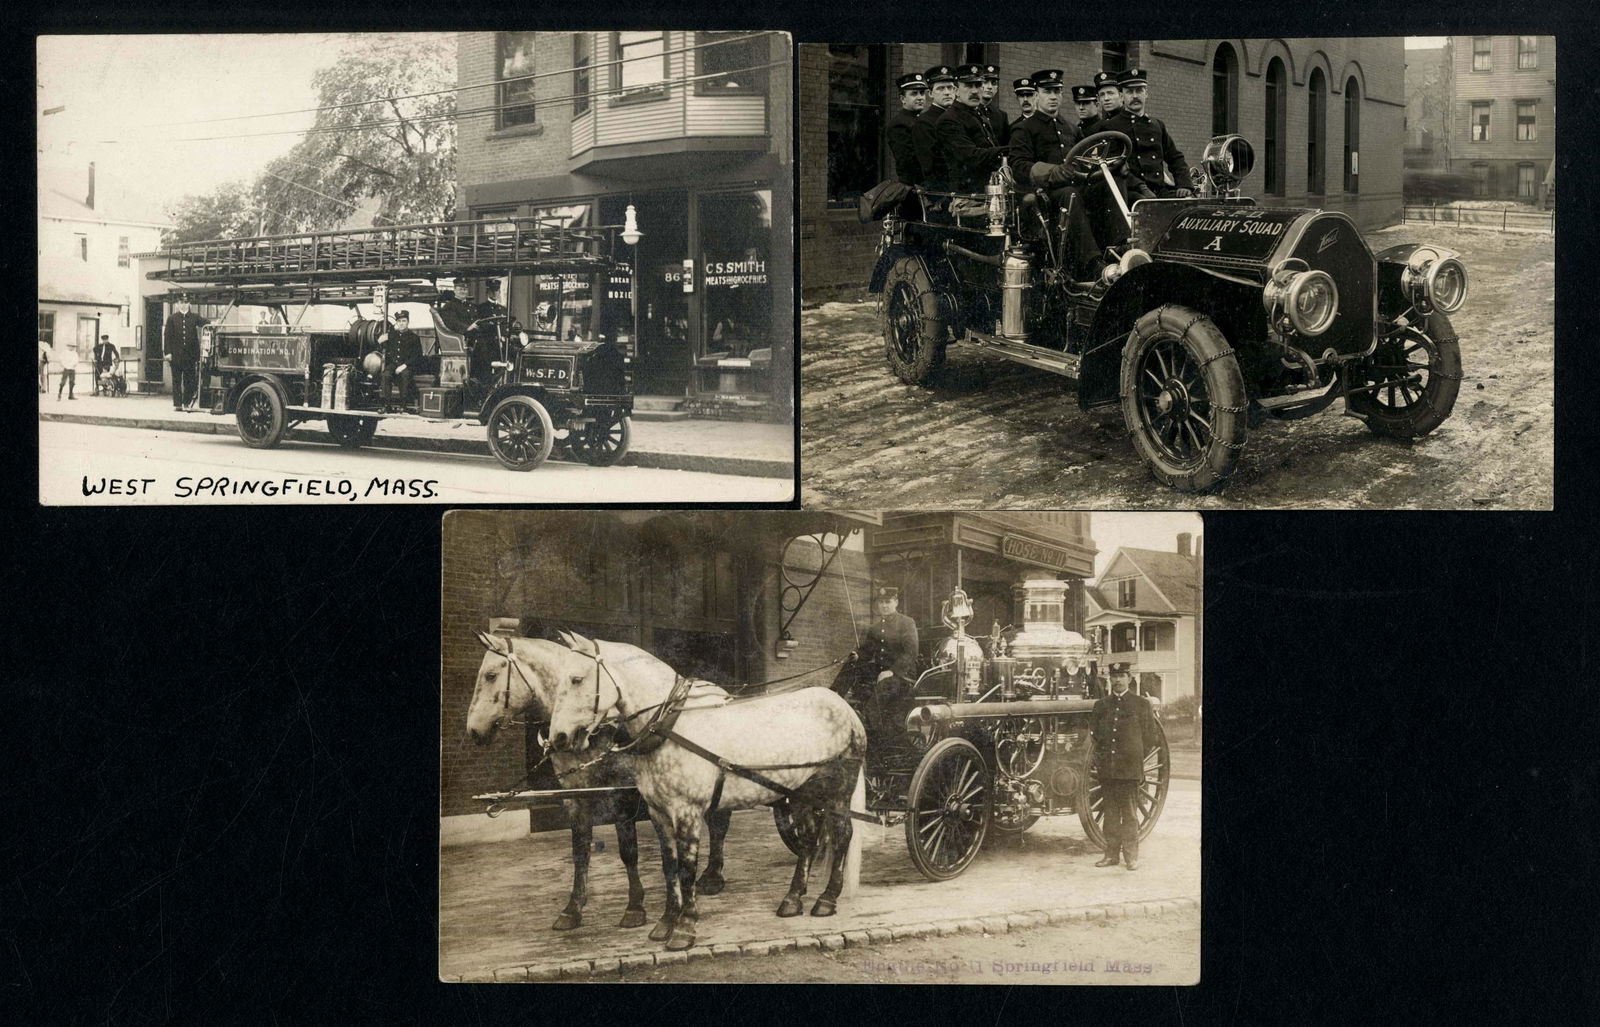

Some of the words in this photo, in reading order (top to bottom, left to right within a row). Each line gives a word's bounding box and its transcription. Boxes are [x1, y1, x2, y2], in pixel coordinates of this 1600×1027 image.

[1177, 217, 1240, 232] AUXILIARY
[1239, 220, 1283, 235] SQUAD
[1203, 236, 1223, 251] A
[664, 272, 681, 282] 86
[705, 276, 726, 285] MEATS
[733, 274, 767, 284] GROCERIES
[608, 291, 633, 299] MOXIE
[228, 347, 276, 356] COMBINATION
[82, 476, 156, 496] WEST
[174, 477, 358, 501] SPRINGFIELD,
[364, 478, 439, 497] MASS.
[1008, 539, 1038, 560] HOSE
